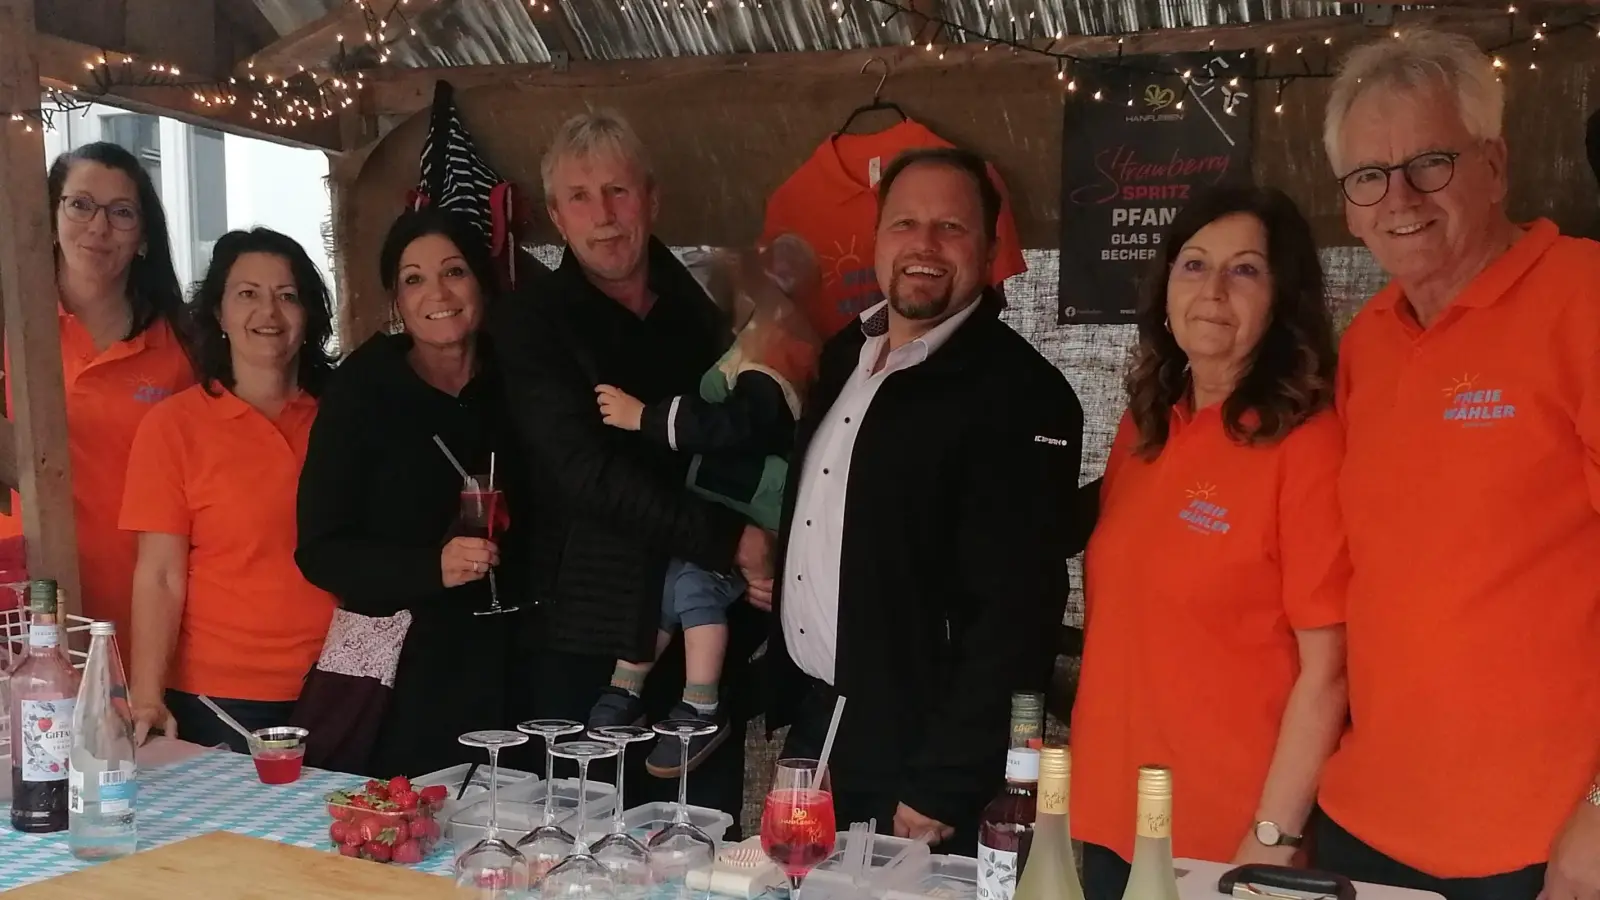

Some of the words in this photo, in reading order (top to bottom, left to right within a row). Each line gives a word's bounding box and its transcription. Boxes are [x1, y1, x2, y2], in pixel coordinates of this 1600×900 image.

[1070, 144, 1231, 205] Strawberry
[1122, 184, 1192, 200] SPRITZ
[1112, 207, 1177, 227] PFAN
[1111, 233, 1148, 245] GLAS
[1101, 249, 1157, 260] BECHER
[45, 730, 71, 740] GIFFA
